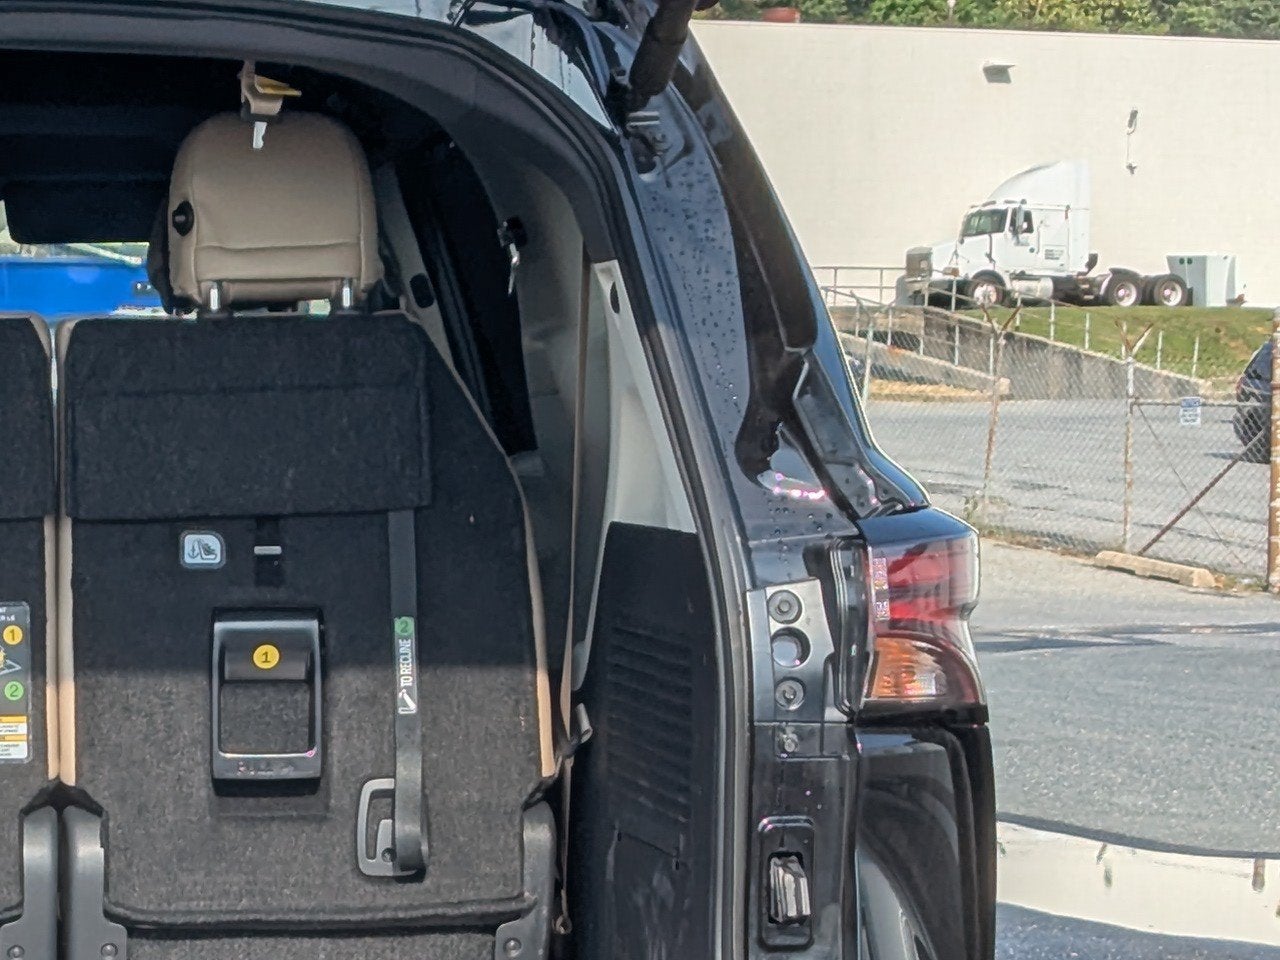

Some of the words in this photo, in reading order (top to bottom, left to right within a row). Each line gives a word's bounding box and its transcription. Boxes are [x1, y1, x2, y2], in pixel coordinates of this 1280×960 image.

[399, 620, 409, 634] 2
[261, 651, 271, 664] 1
[9, 684, 19, 697] 2
